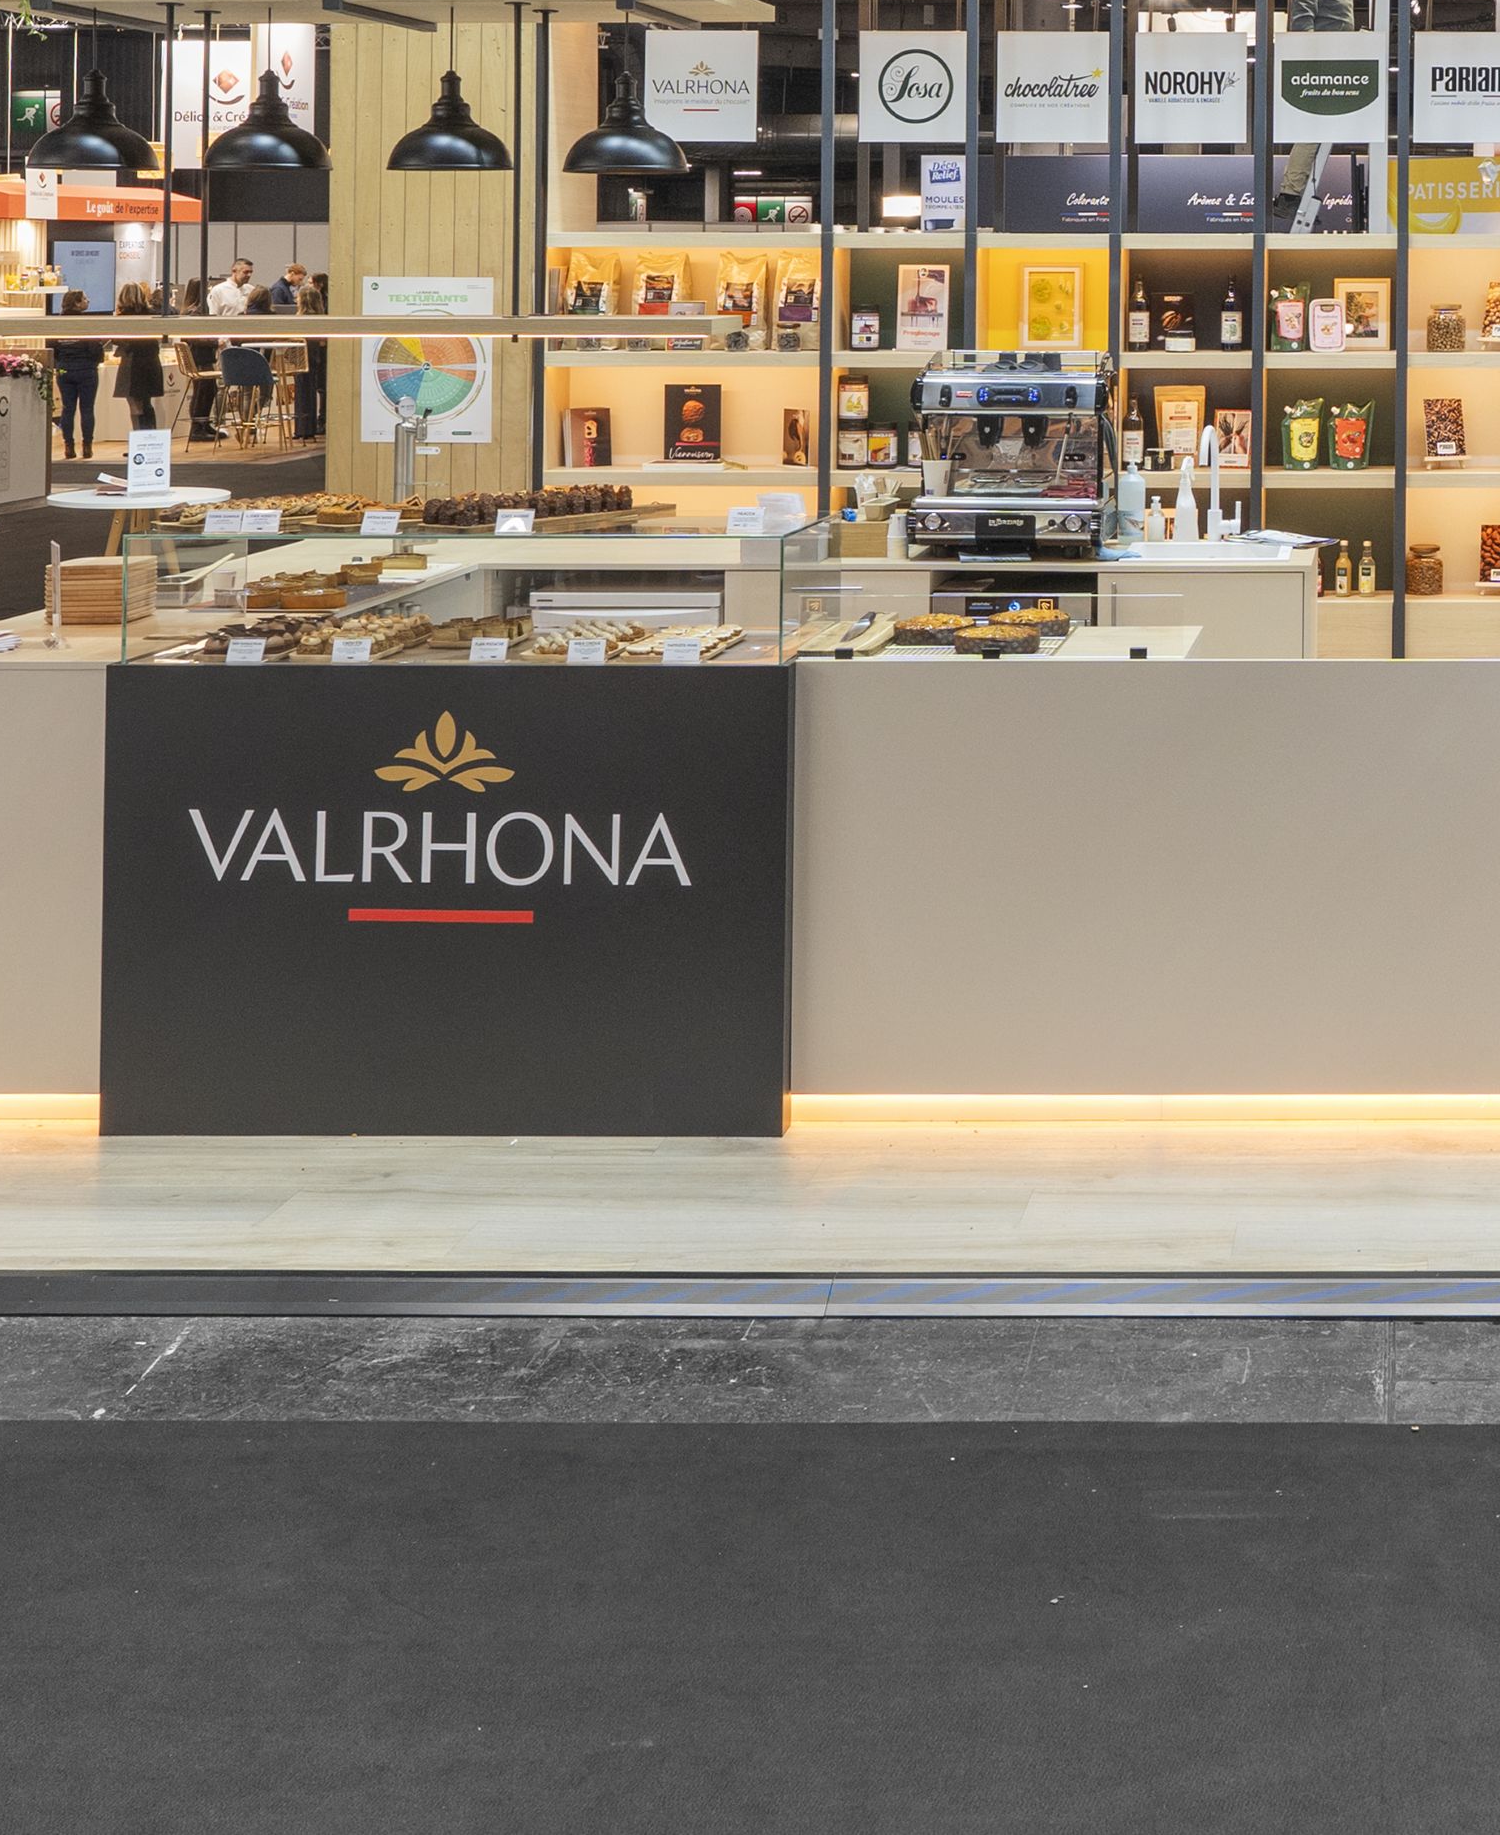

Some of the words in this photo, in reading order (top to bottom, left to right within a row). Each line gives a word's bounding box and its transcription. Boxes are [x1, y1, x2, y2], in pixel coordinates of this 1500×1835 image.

[884, 65, 944, 104] Sosa
[1004, 73, 1099, 98] chocolatree
[1145, 71, 1225, 96] NOROHY
[1291, 72, 1370, 86] adamance
[652, 79, 750, 95] VALRHONA
[1300, 88, 1321, 98] fruits
[925, 195, 965, 204] MOULES
[1067, 192, 1110, 206] Colorants
[1187, 191, 1221, 206] Arômes
[1225, 191, 1236, 206] &
[85, 199, 96, 213] Le
[96, 200, 114, 217] goût
[115, 201, 124, 214] de
[125, 203, 159, 217] l'expertise
[388, 294, 468, 303] TEXTURANTS
[188, 807, 693, 887] VALRHONA
